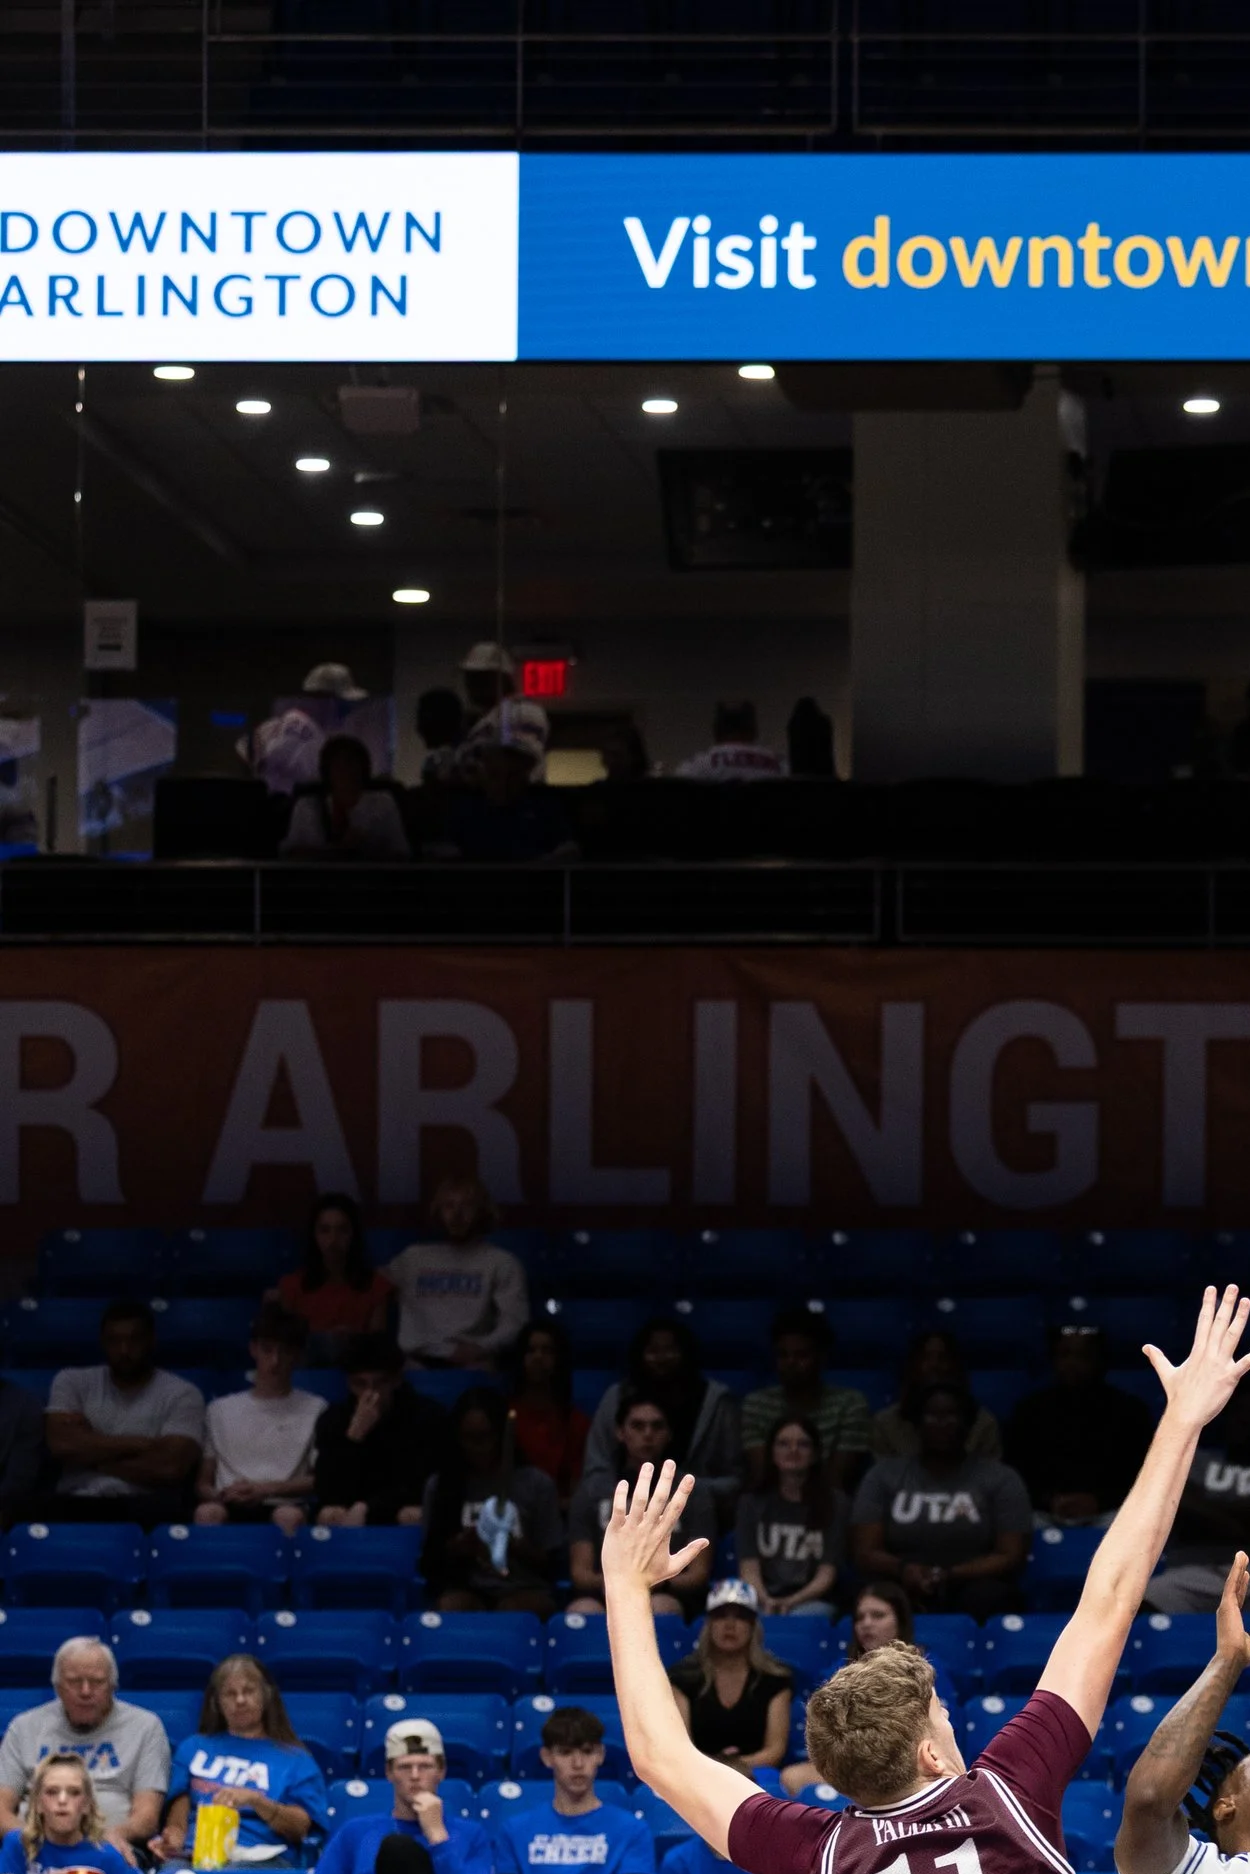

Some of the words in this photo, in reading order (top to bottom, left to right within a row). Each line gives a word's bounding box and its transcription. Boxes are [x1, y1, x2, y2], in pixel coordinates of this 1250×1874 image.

[0, 210, 443, 254] DOWNTOWN
[624, 214, 817, 290] Visit
[0, 273, 409, 317] ARLINGTON
[0, 1000, 127, 1204] R
[891, 1490, 980, 1524] UTA
[757, 1522, 823, 1559] UTA
[189, 1749, 269, 1790] UTA
